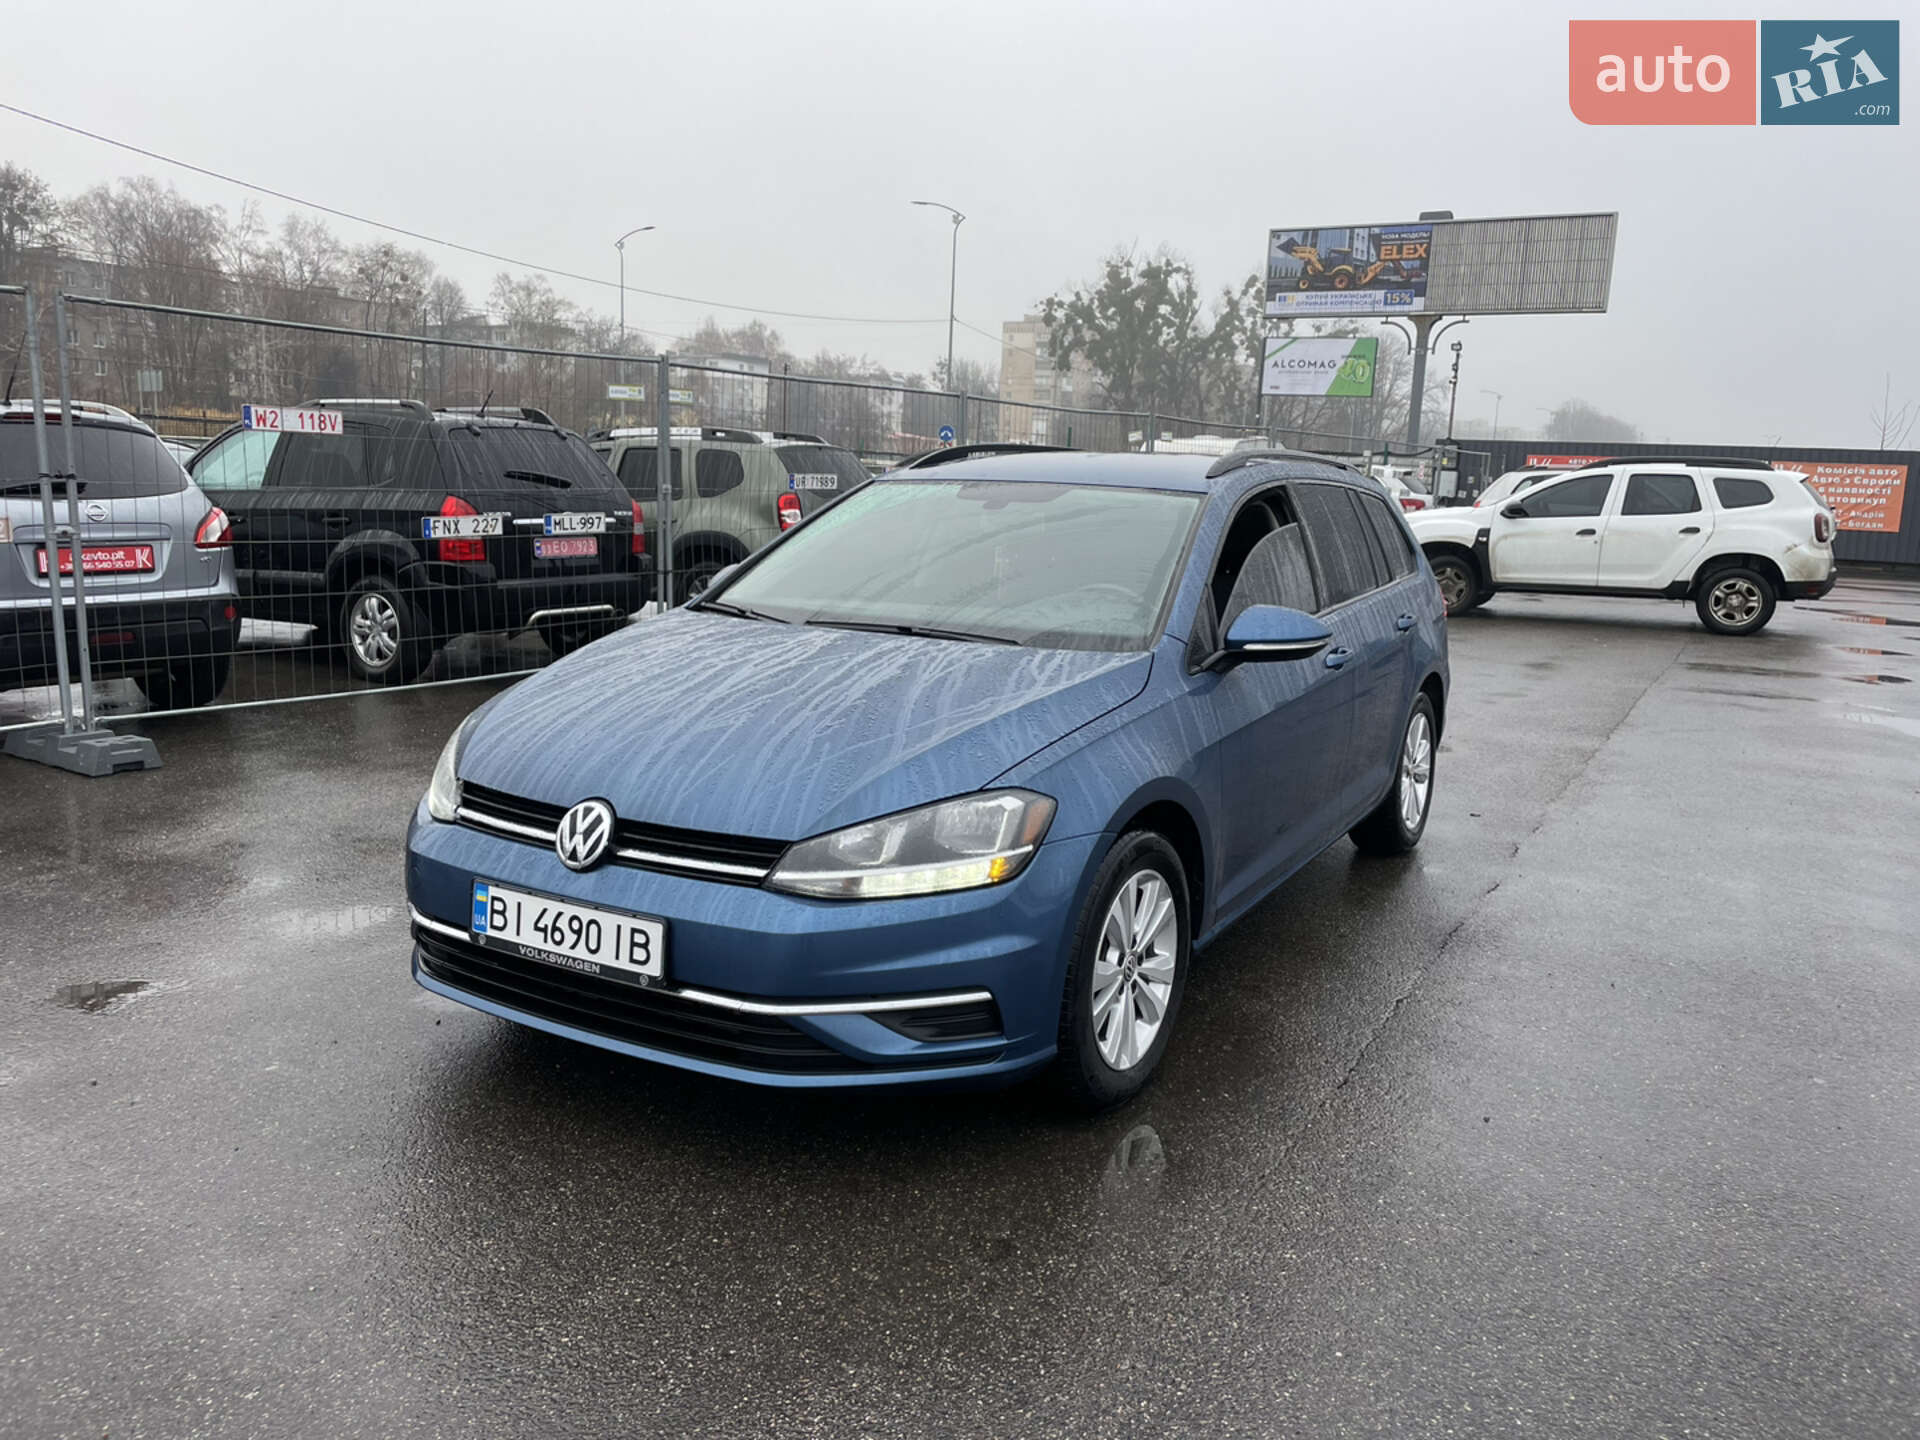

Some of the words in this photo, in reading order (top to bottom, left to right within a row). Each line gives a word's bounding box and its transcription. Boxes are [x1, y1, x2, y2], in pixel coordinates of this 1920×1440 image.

[1380, 243, 1429, 260] ELEX
[1385, 291, 1412, 304] 15%
[1272, 359, 1337, 369] ALCOMAG
[255, 409, 279, 429] W2
[298, 412, 338, 431] 118V
[1817, 465, 1865, 475] Комісія
[1868, 468, 1898, 476] авто
[1811, 475, 1841, 484] Авто
[1828, 487, 1891, 495] наявності
[432, 519, 460, 535] FNX
[472, 518, 499, 534] 227
[553, 518, 577, 531] MLL
[579, 516, 602, 530] 997
[474, 913, 487, 926] UA
[490, 895, 521, 937] BI
[533, 907, 602, 955] 4690
[615, 924, 651, 966] IB
[519, 945, 600, 974] VOLKSWAGEN
